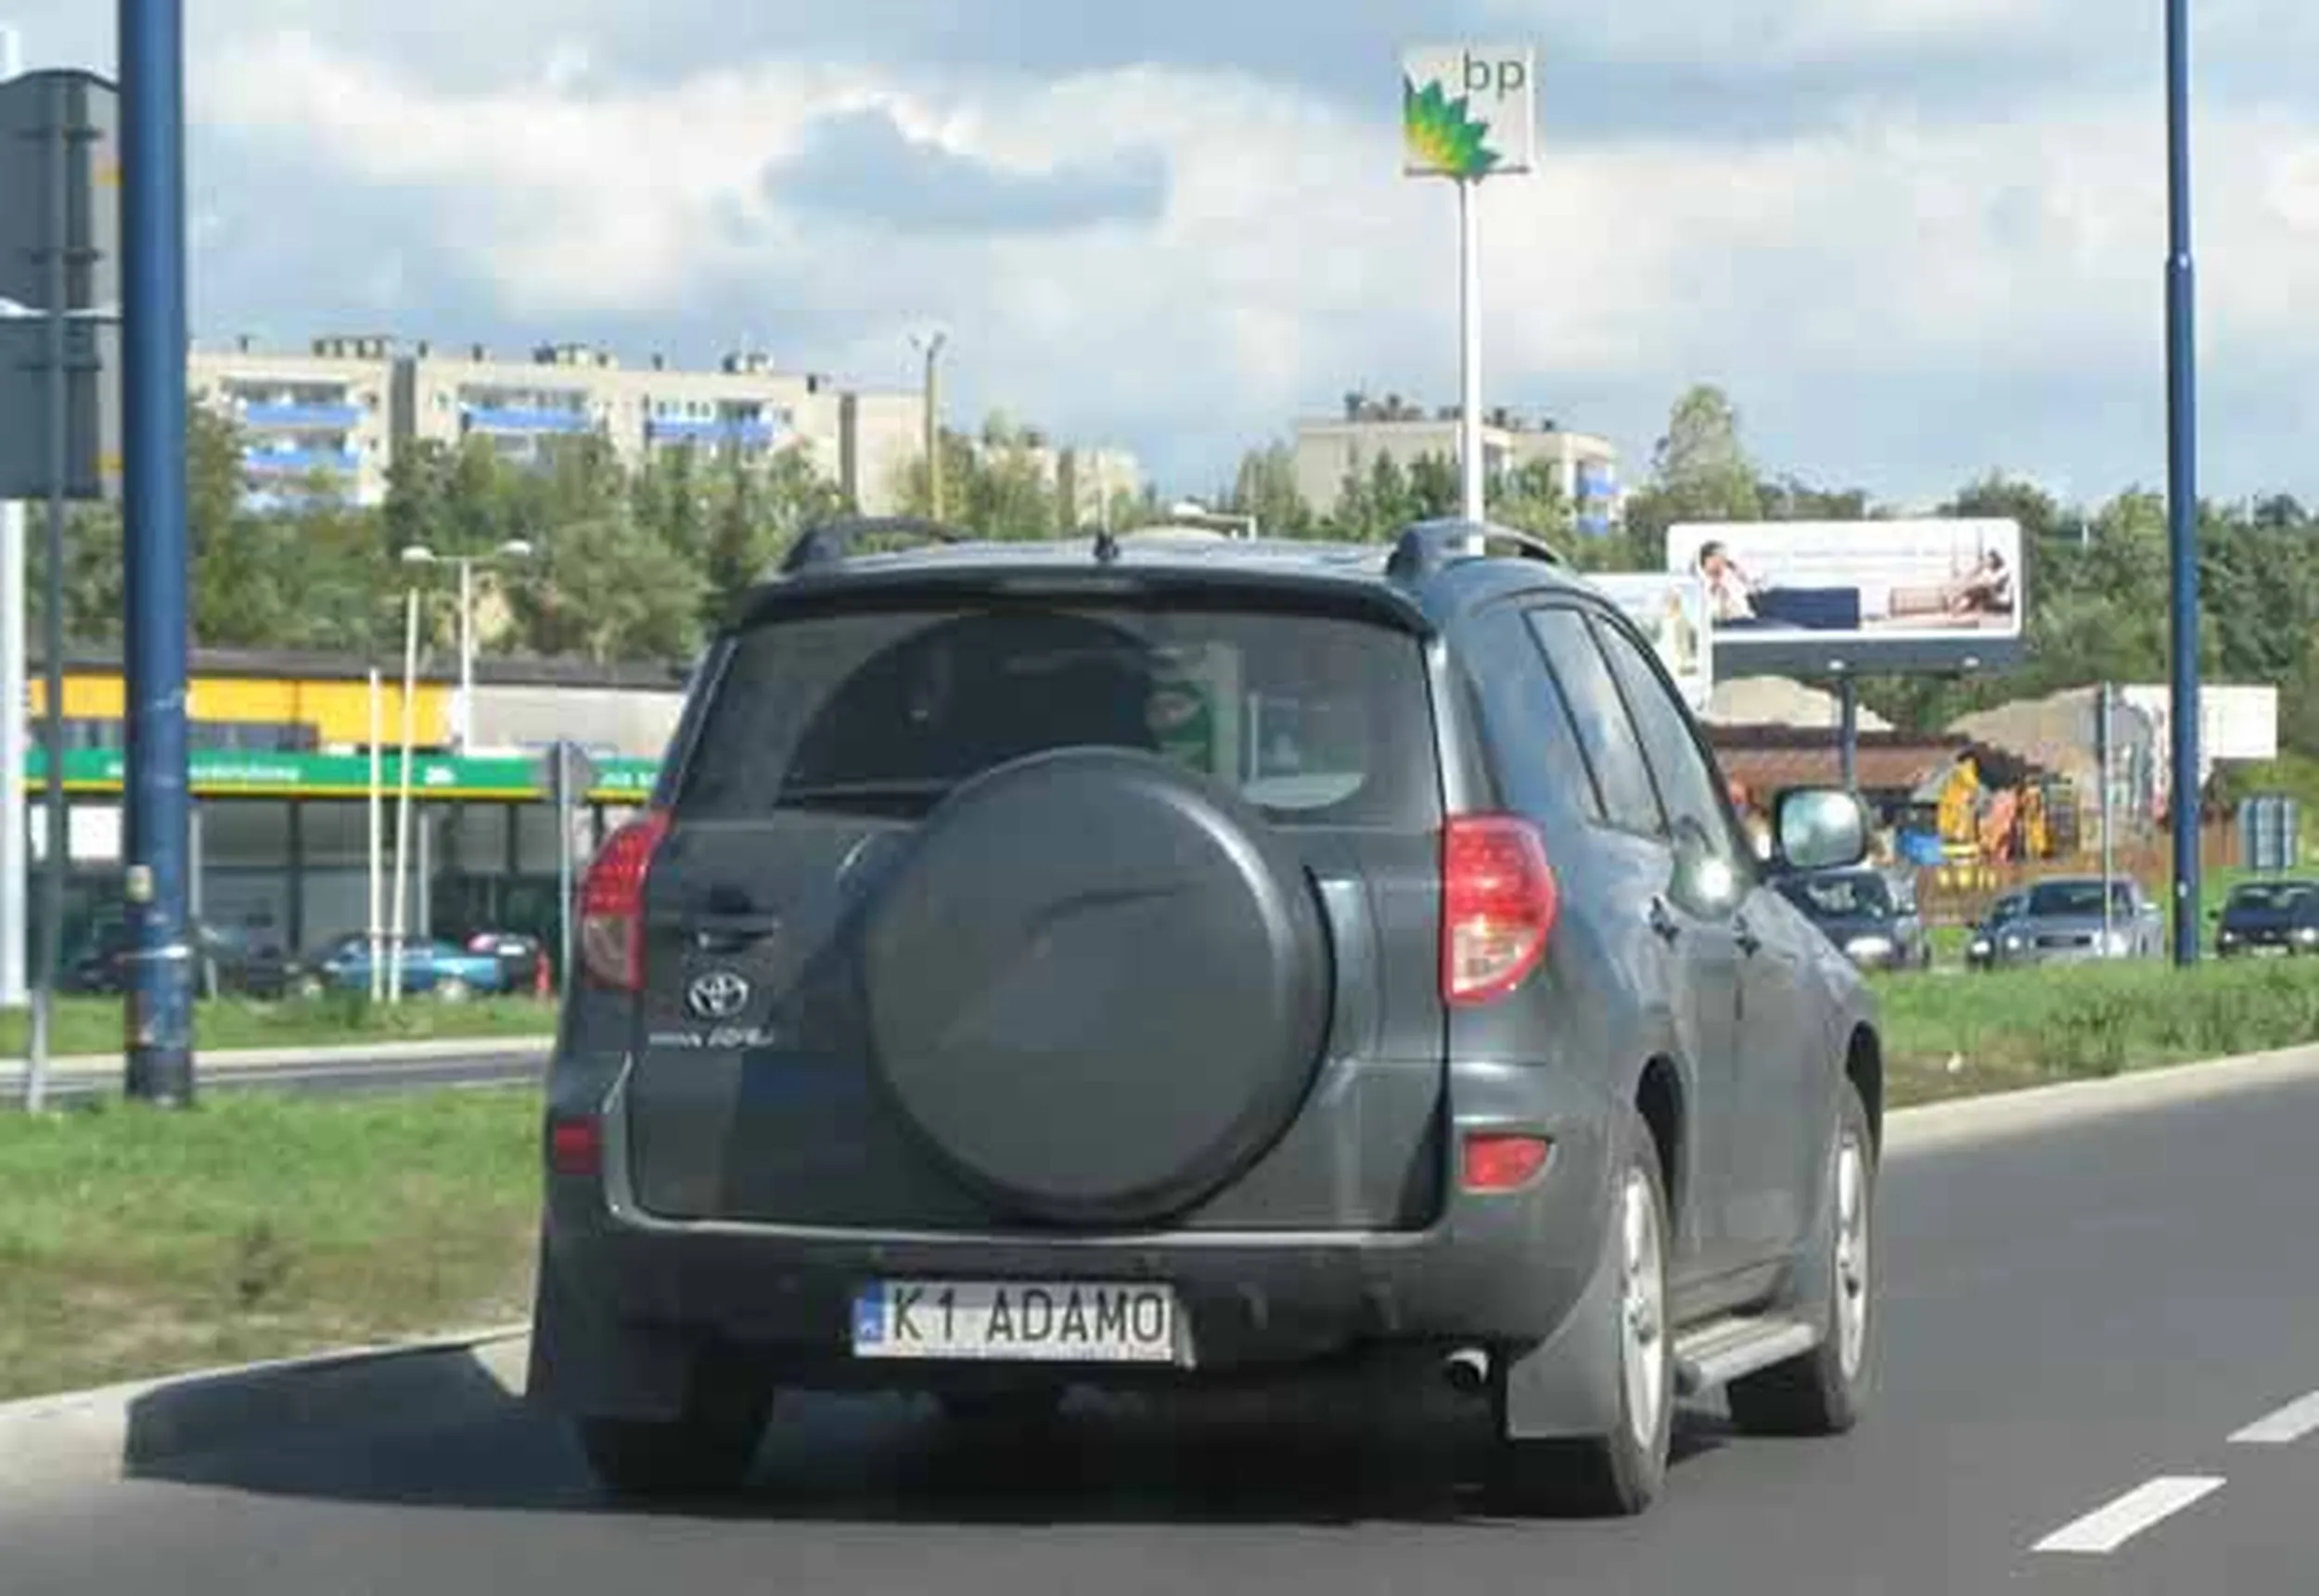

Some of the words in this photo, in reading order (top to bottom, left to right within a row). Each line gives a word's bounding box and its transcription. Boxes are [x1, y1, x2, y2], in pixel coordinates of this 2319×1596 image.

[1463, 49, 1526, 103] bp
[894, 1287, 956, 1341] K1
[986, 1287, 1165, 1342] ADAMO
